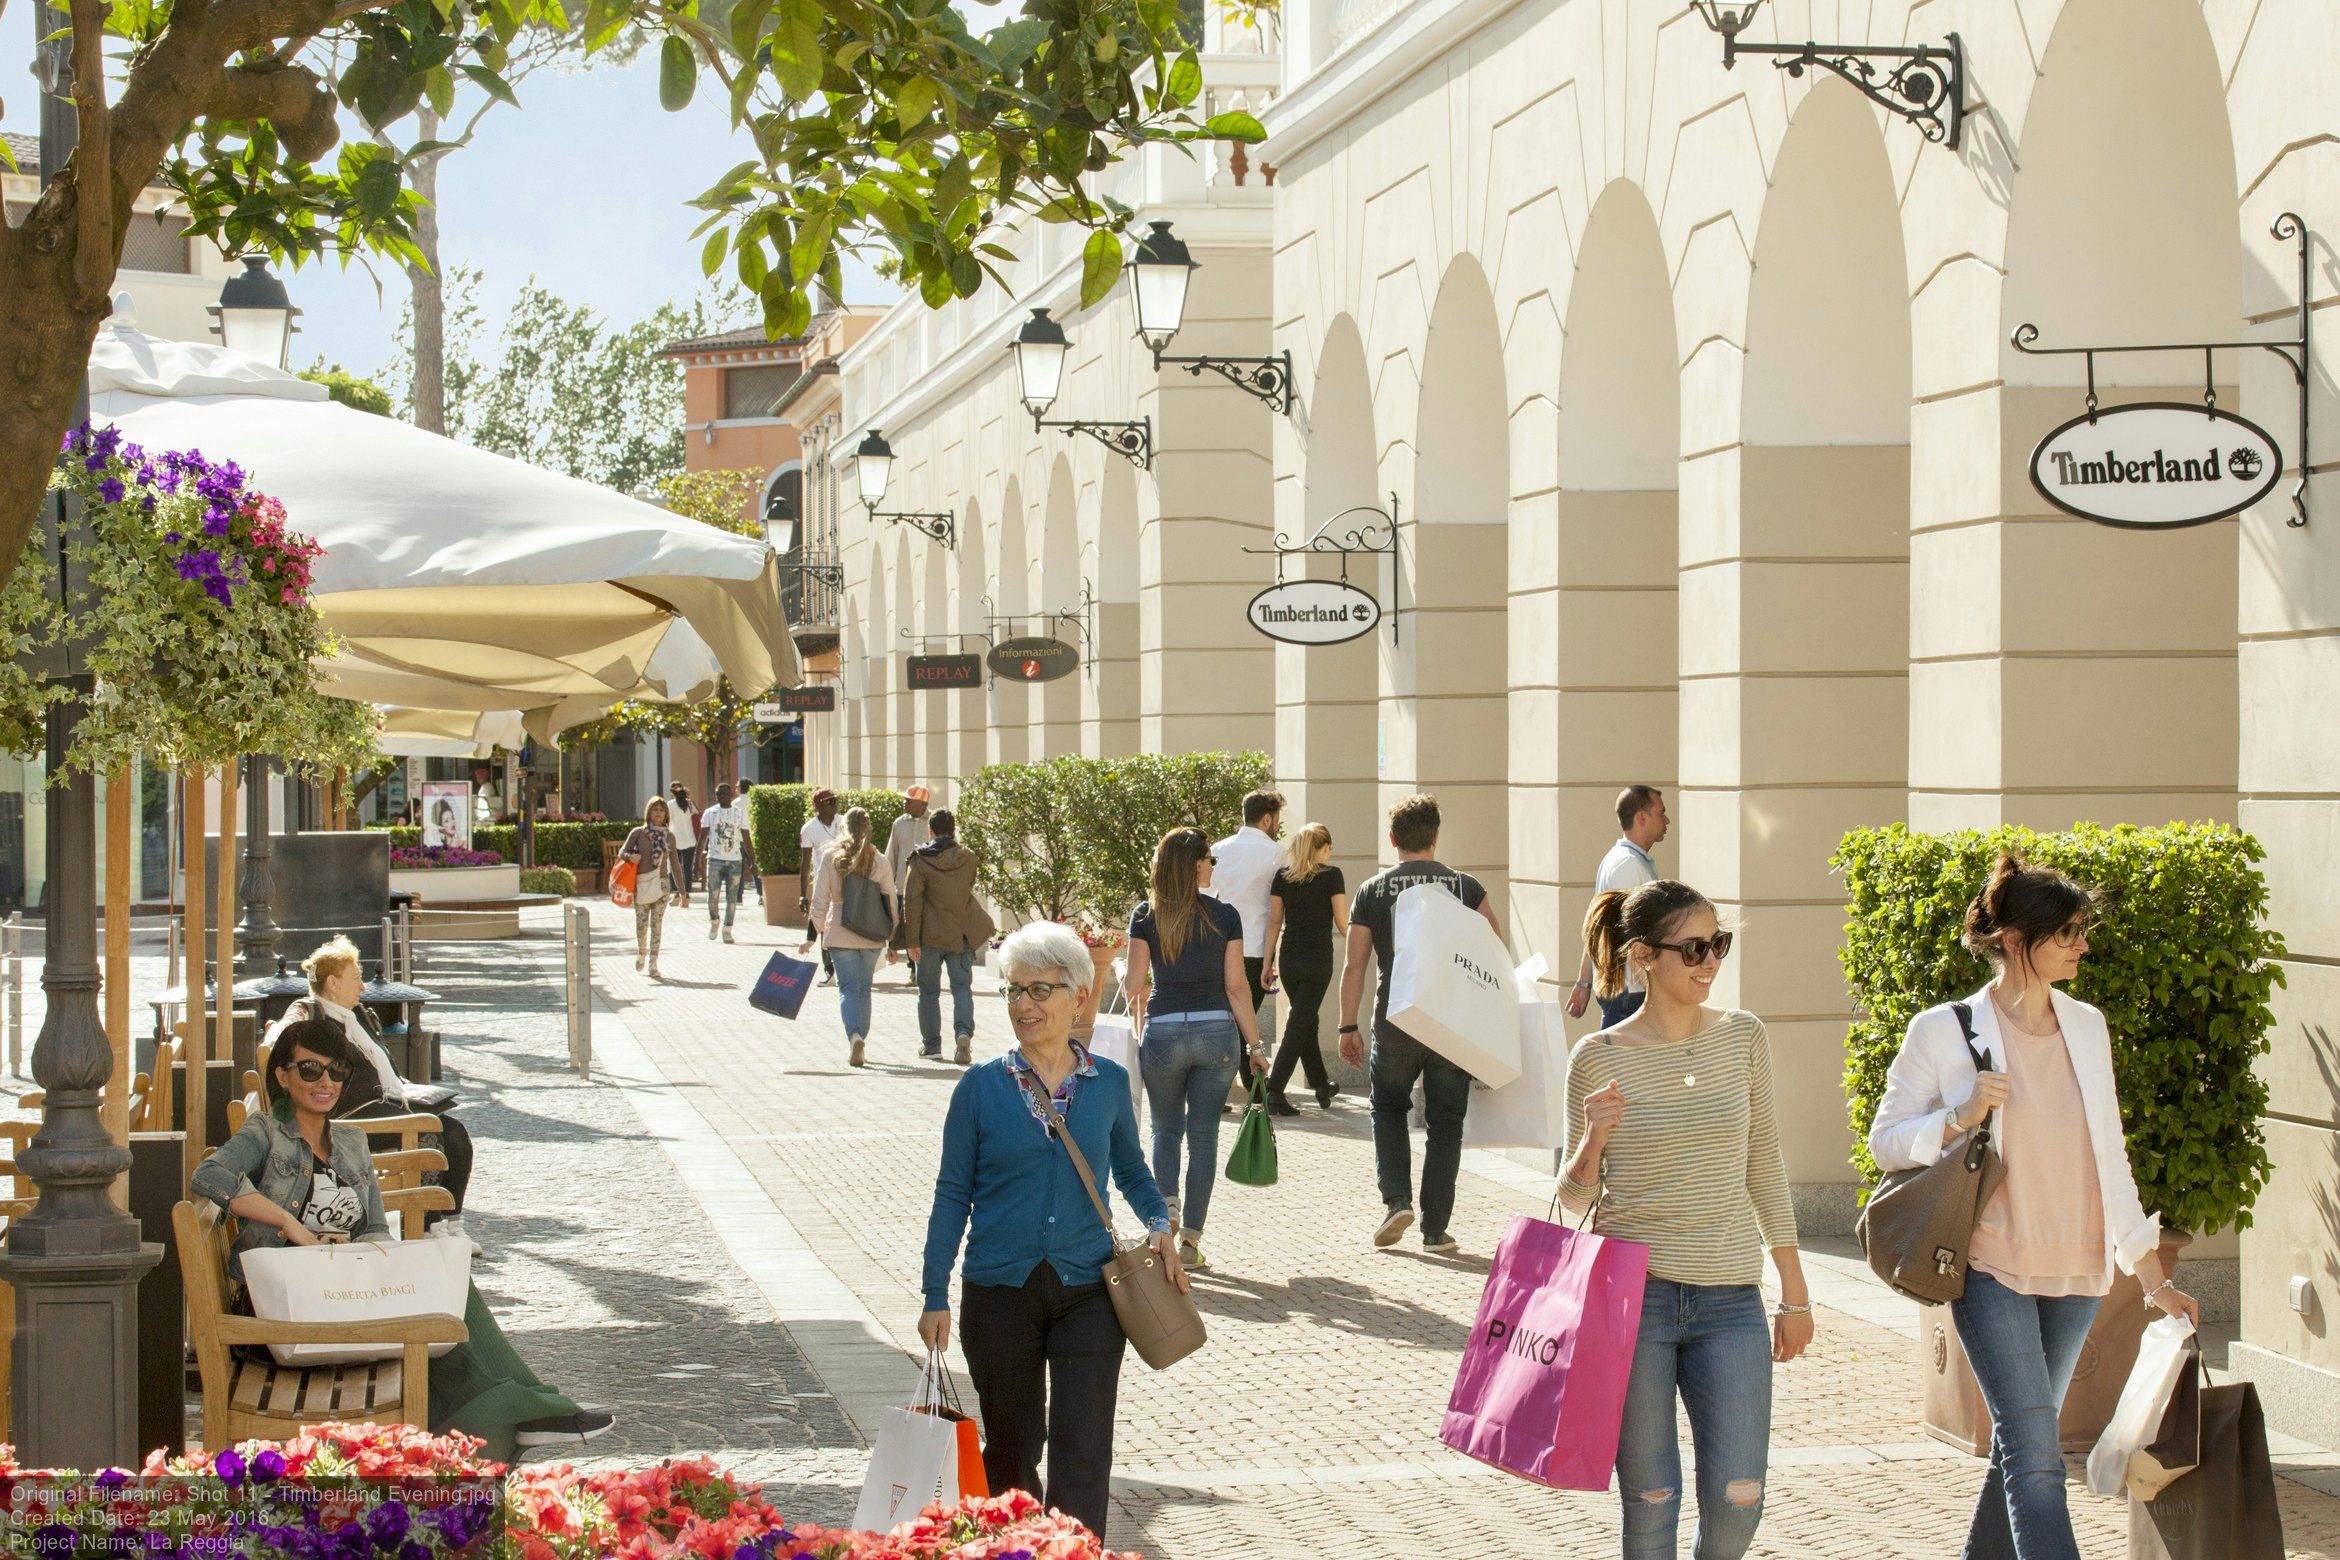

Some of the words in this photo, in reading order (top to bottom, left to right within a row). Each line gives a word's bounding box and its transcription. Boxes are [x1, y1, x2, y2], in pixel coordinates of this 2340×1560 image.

[2051, 447, 2222, 485] Timberland
[1258, 603, 1348, 622] Timberland
[1000, 646, 1063, 659] Informazioni
[915, 665, 972, 681] REPLAY
[785, 695, 828, 705] REPLAY
[1454, 952, 1500, 991] PRADA
[323, 1288, 378, 1302] ROBERTA
[380, 1283, 416, 1297] BIAGI
[1485, 1318, 1559, 1366] PINKO
